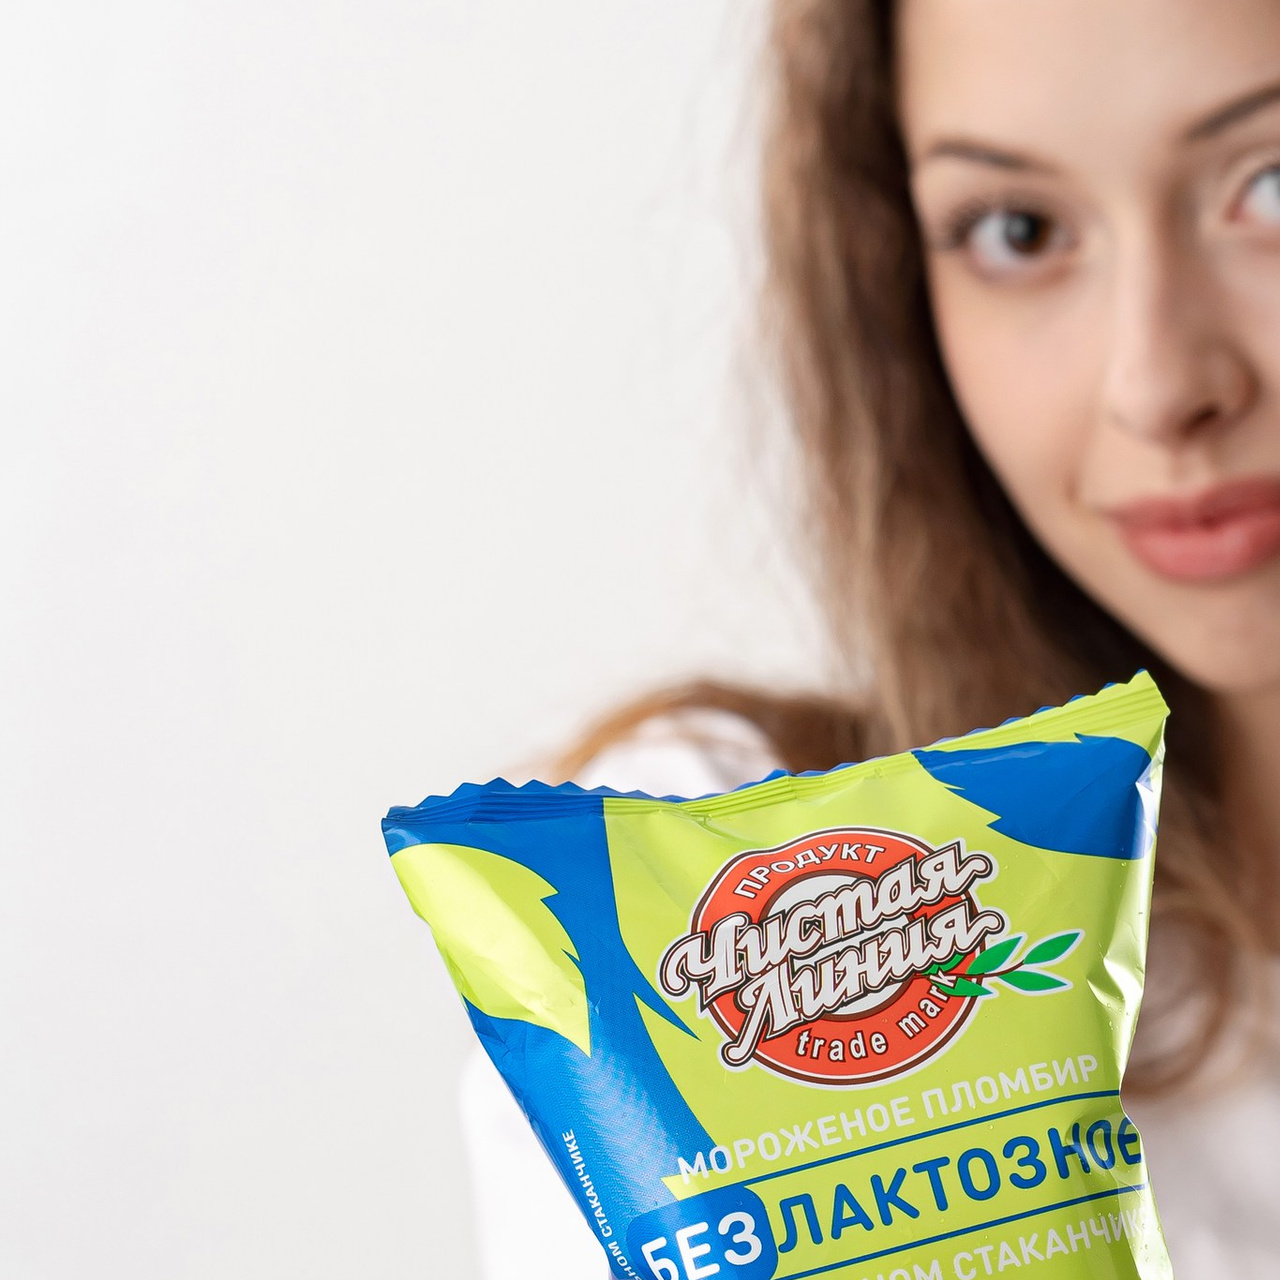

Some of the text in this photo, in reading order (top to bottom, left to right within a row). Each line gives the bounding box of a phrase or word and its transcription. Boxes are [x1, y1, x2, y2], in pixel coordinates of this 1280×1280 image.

[733, 842, 886, 899] ПРОДУКТ
[661, 841, 994, 1011] Чистая
[722, 902, 1006, 1065] Линия
[797, 969, 958, 1062] trade mark
[677, 1054, 1097, 1185] МОРОЖЕНОЕ ПЛОМБИР
[562, 1128, 613, 1238] СТАКАНЧИКЕ
[953, 1208, 1144, 1280] СТАКАНЧИК
